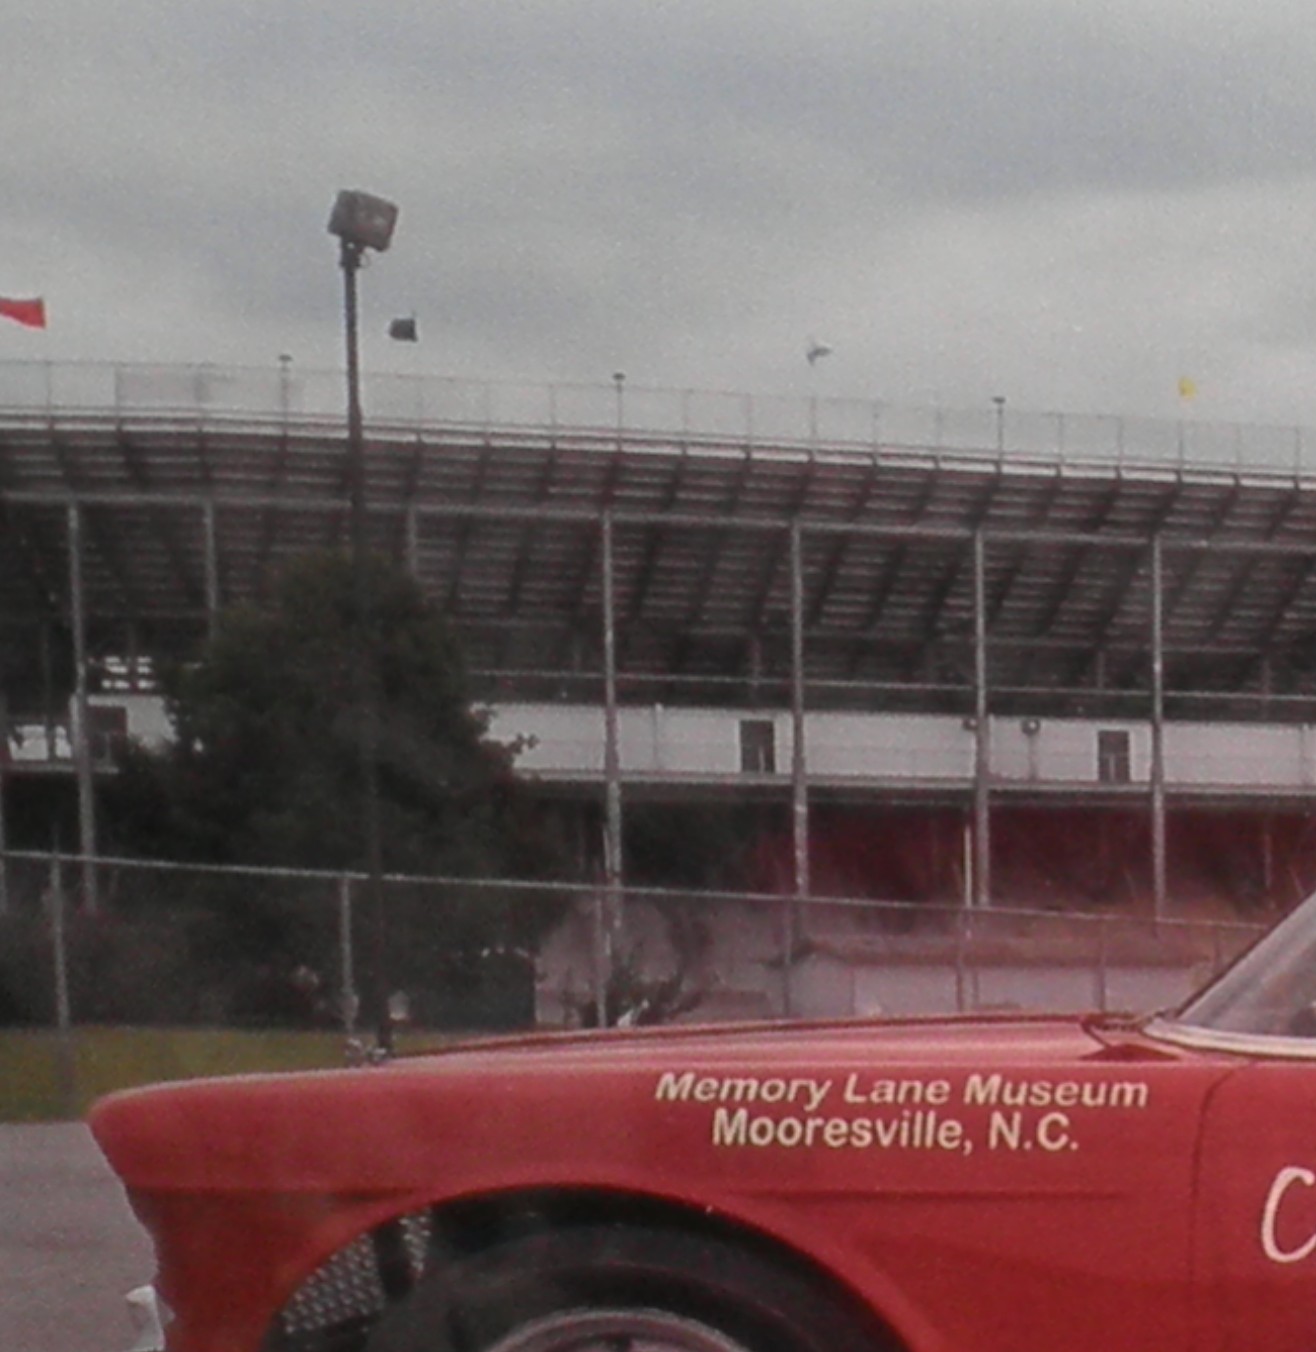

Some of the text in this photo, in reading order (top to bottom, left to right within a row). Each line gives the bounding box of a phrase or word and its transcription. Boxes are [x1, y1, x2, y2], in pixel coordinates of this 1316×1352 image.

[655, 1073, 1149, 1110] Memory Lane Museum
[712, 1108, 1080, 1156] Mooresville, N.C.
